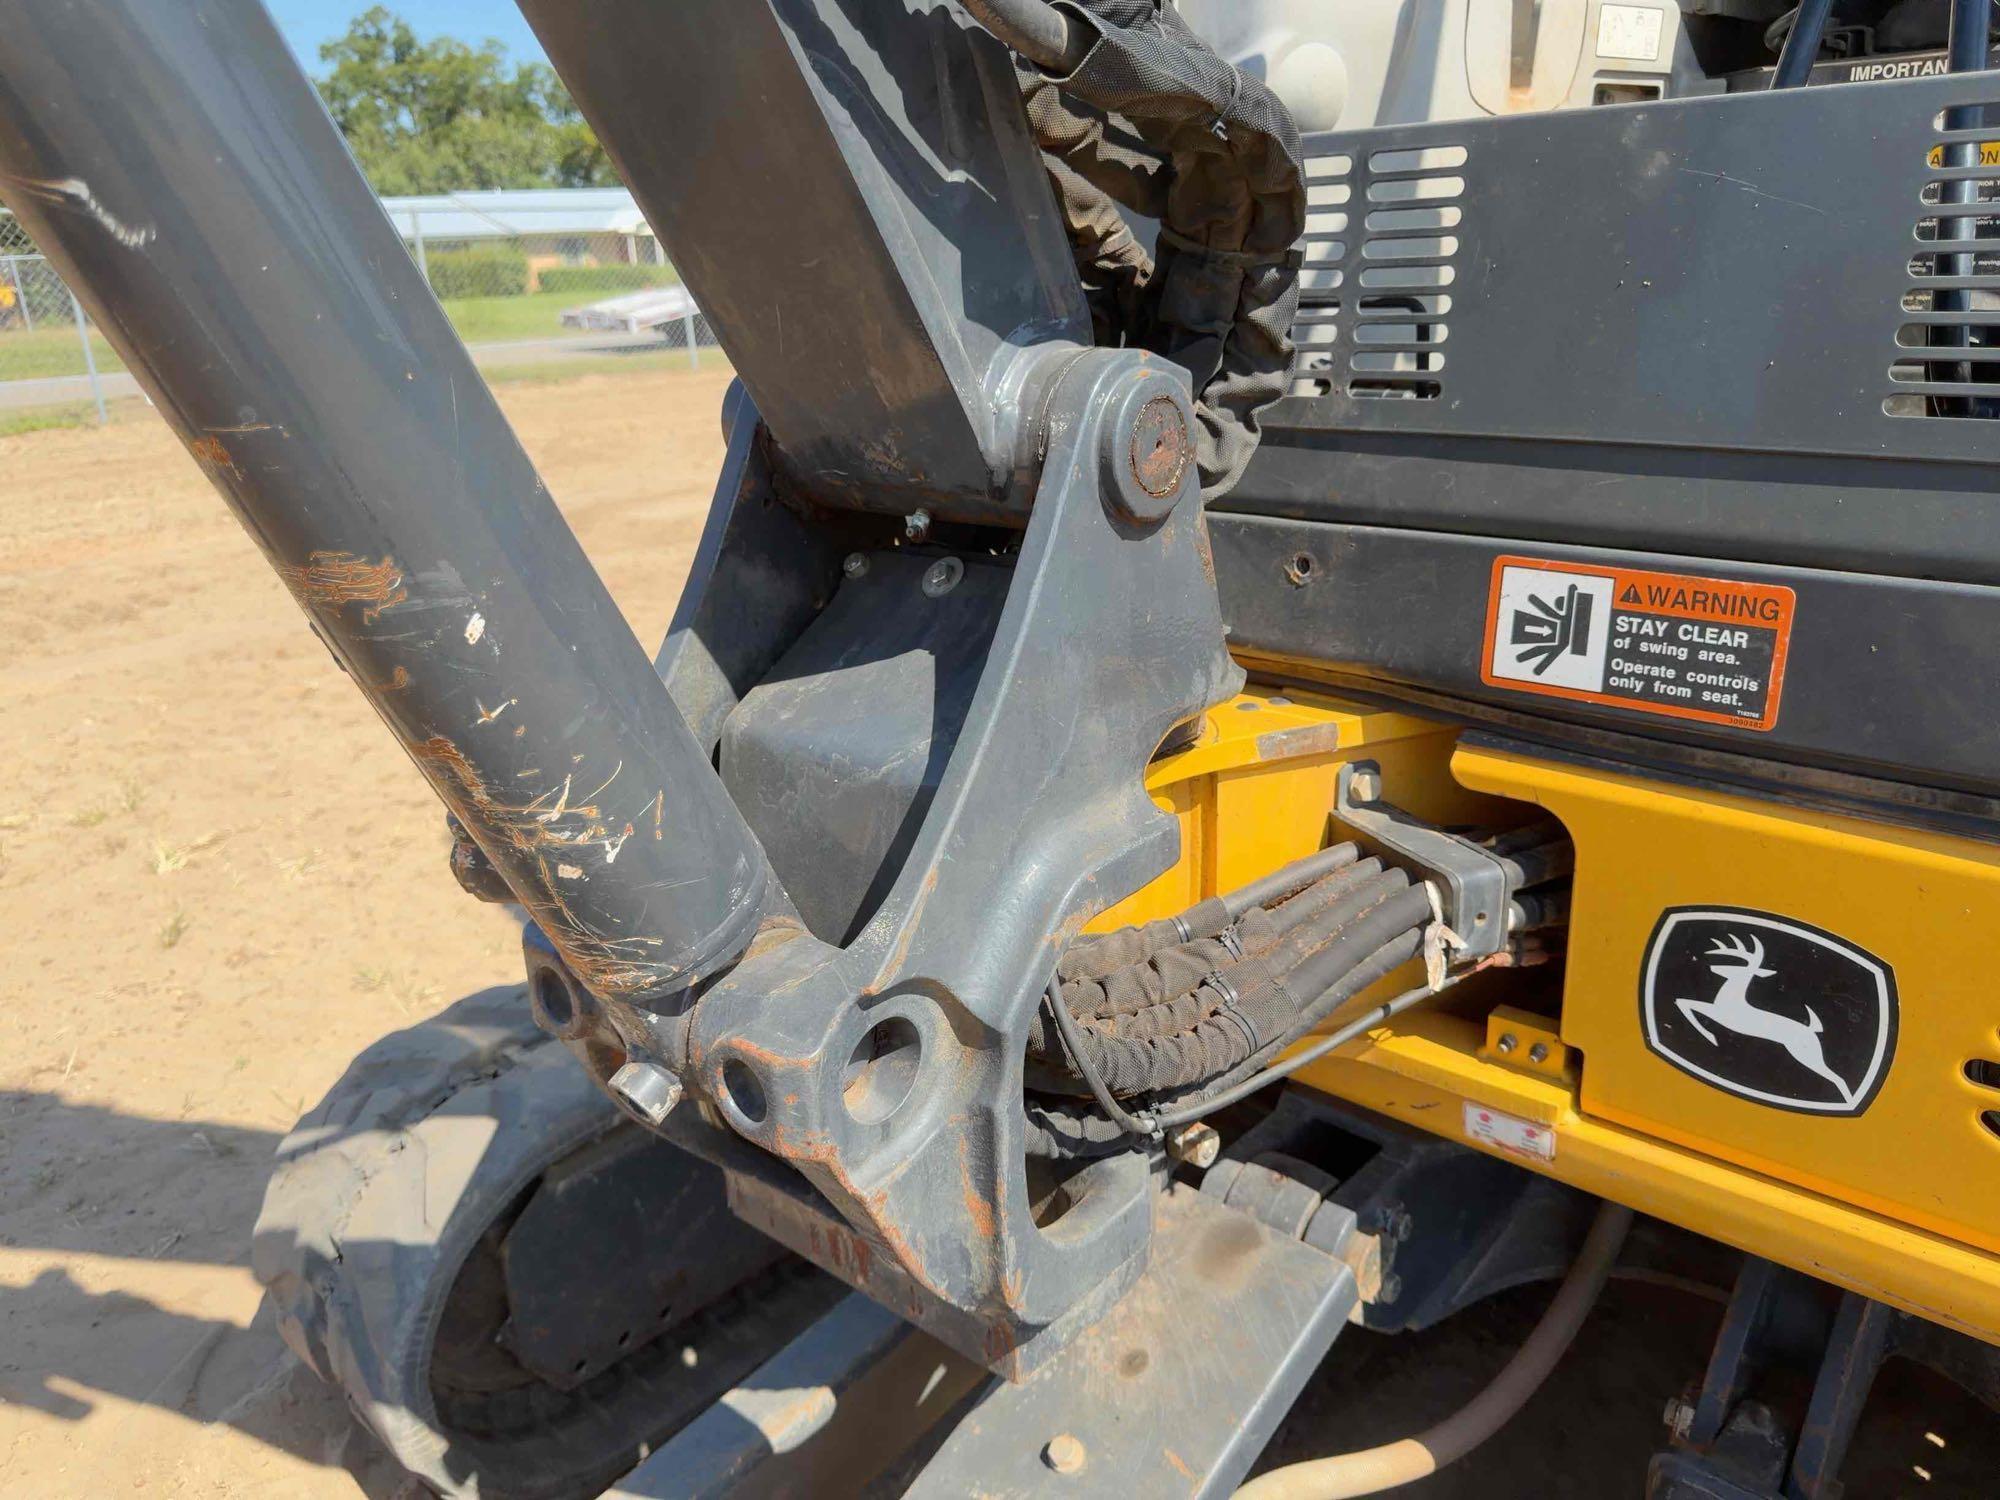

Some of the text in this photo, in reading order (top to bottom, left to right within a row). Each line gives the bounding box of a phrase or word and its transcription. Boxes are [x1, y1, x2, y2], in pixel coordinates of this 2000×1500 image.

[1850, 59, 1949, 81] IMPORTAN
[1648, 585, 1780, 621] WARNING
[1615, 616, 1749, 649] STAY CLEAR
[1613, 637, 1741, 665] of swing area.
[1611, 658, 1759, 692] Operate controls
[1609, 676, 1743, 706] only from seat.
